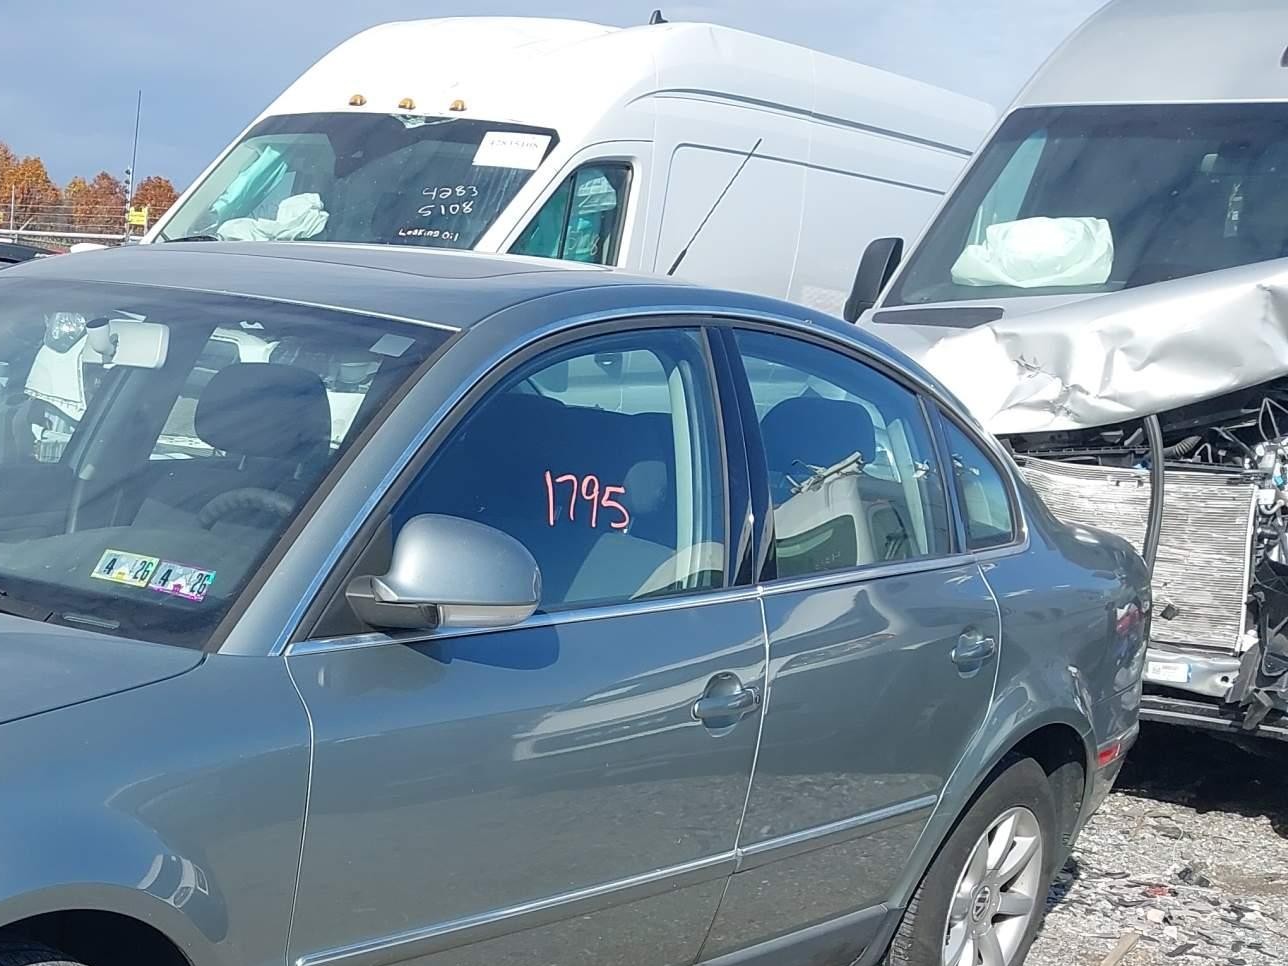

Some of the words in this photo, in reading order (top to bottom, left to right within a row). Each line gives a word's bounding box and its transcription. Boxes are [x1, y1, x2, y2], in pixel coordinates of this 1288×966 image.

[422, 185, 479, 200] 4283
[417, 200, 474, 217] 5108
[545, 470, 630, 528] 1795
[103, 558, 117, 575] 4
[136, 560, 154, 581] 26
[159, 568, 173, 587] 4
[190, 573, 210, 594] 26
